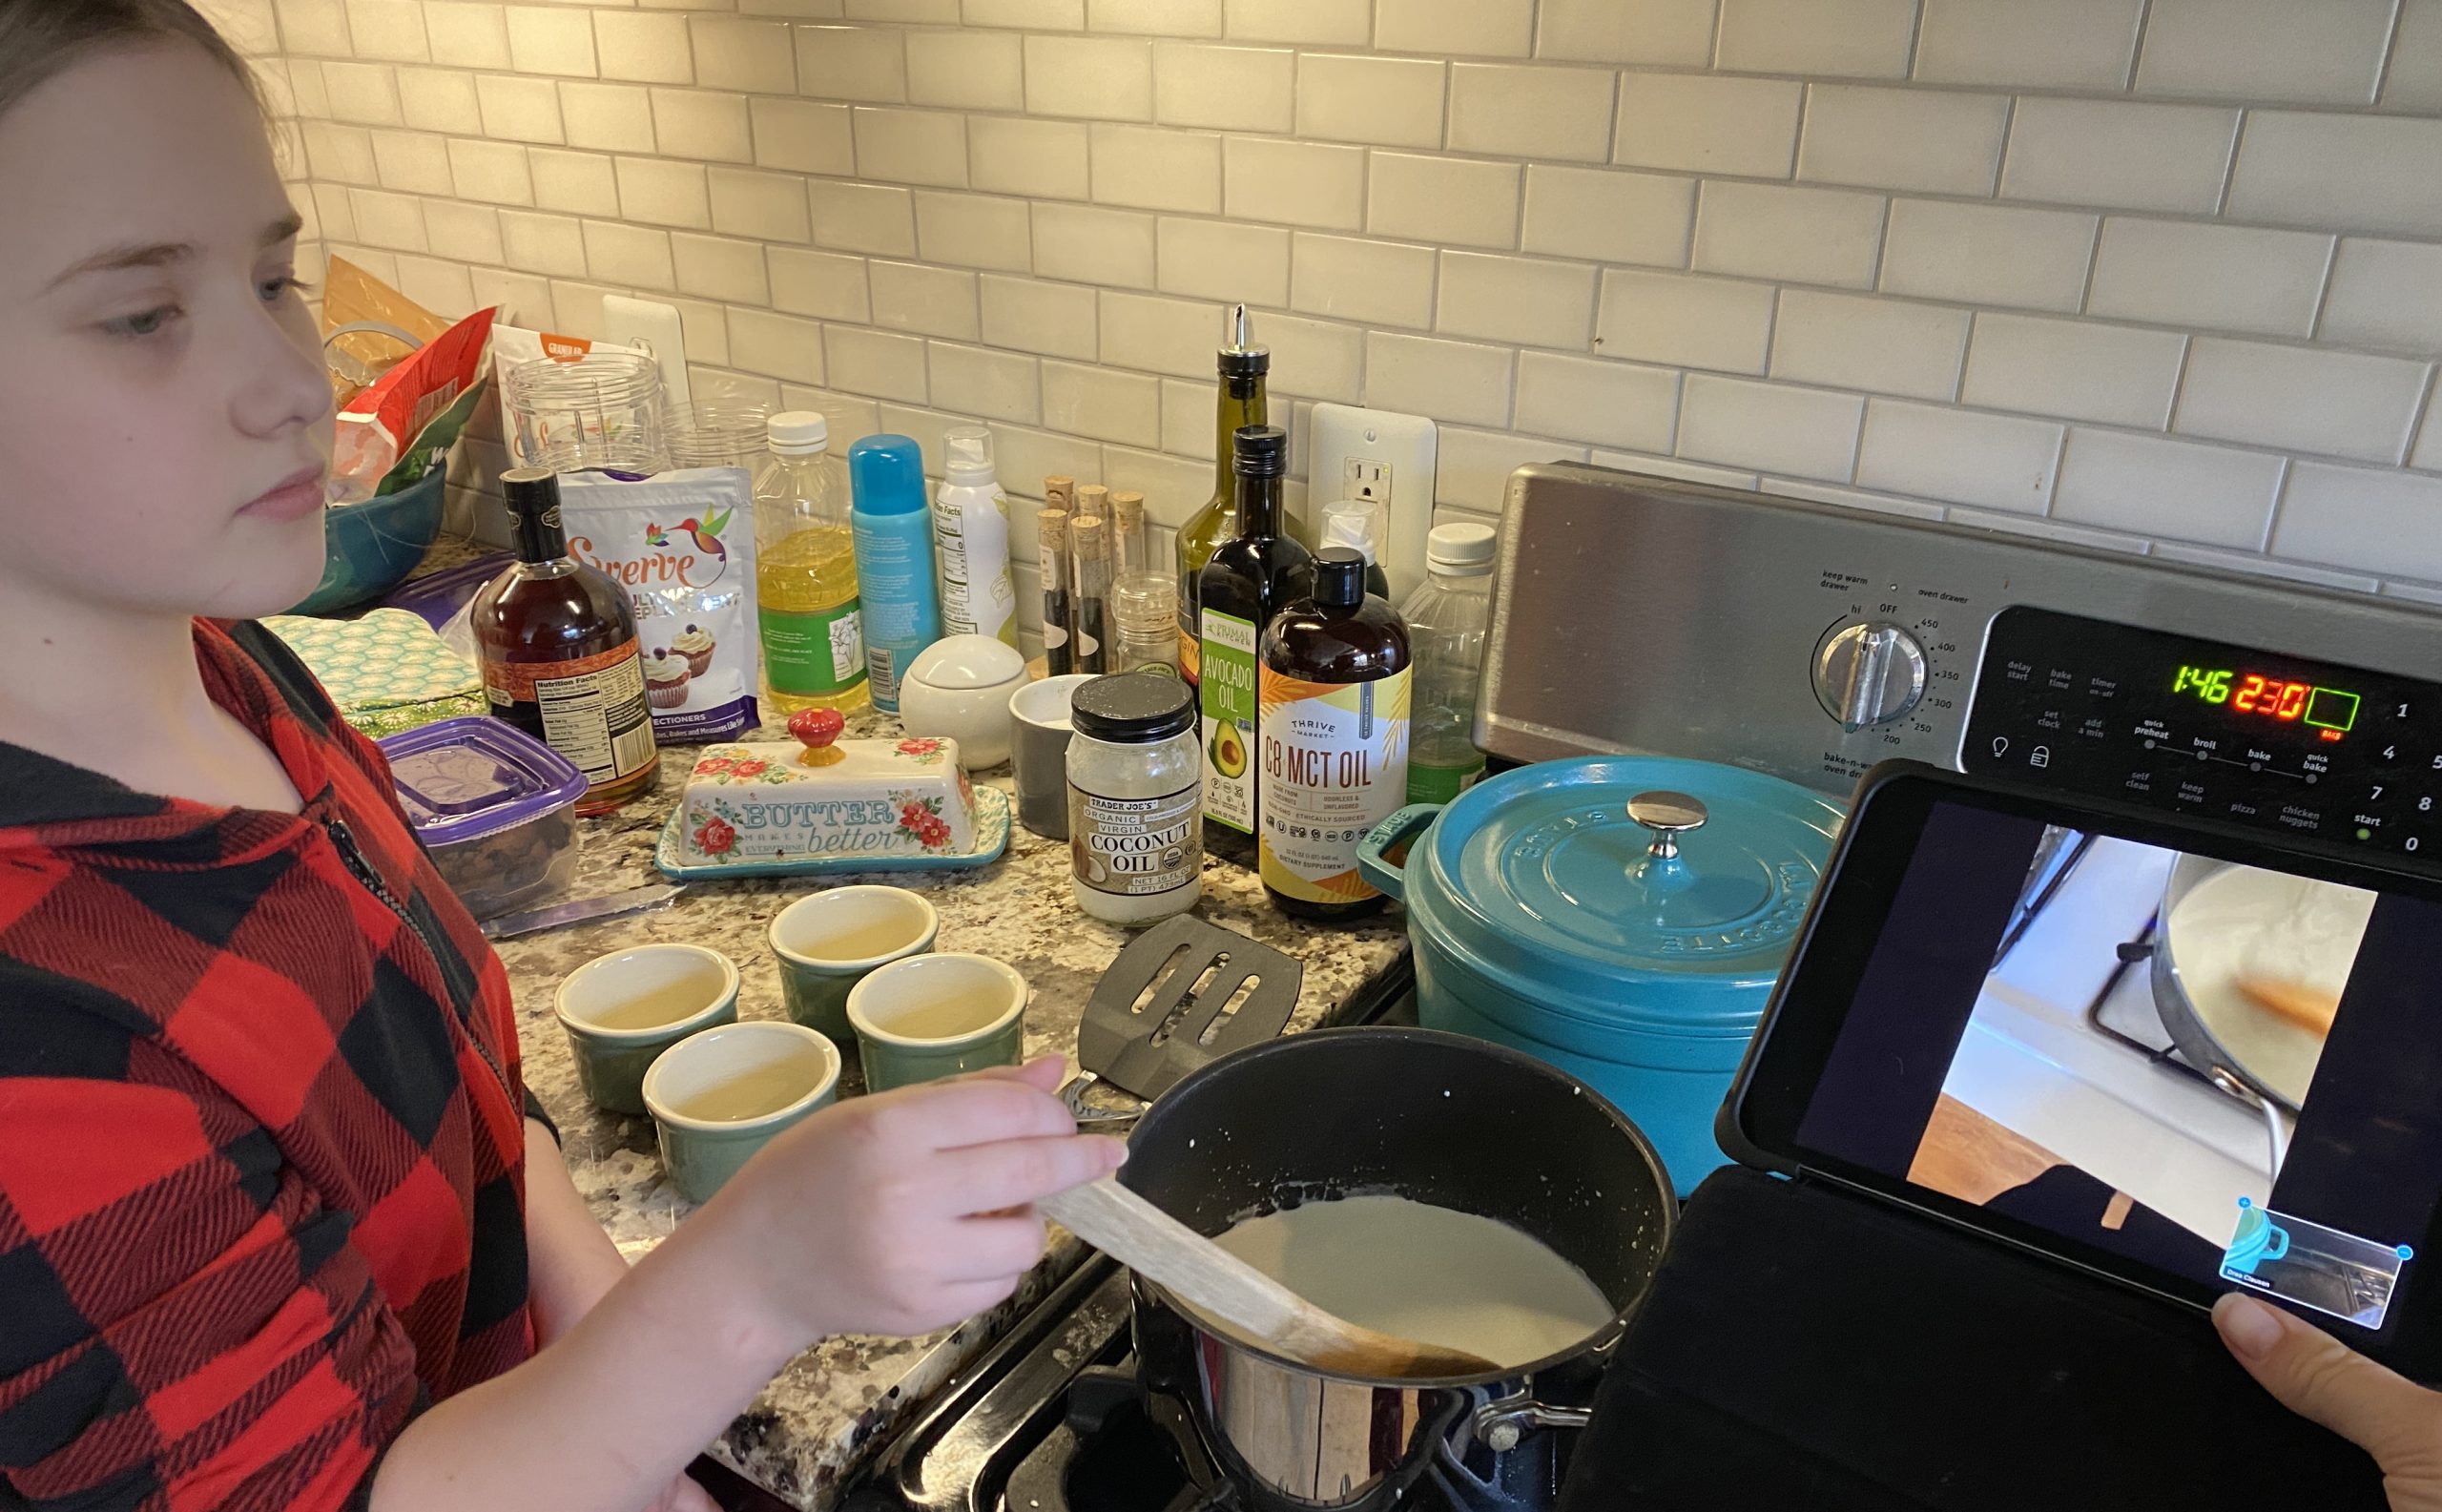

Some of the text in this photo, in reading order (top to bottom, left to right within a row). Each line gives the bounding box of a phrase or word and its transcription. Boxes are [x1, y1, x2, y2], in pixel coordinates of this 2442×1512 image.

[1823, 570, 1868, 586] keep warm
[1820, 579, 1850, 591] drawer
[1918, 588, 1969, 604] oven drawer
[1851, 605, 1862, 613] hi
[1879, 603, 1897, 613] OFF
[1921, 618, 1938, 629] 450
[1217, 623, 1250, 641] PRIMAL
[1937, 642, 1956, 652] 400
[2007, 660, 2032, 673] delay
[1205, 654, 1252, 692] AVOCADO
[1940, 671, 1959, 680] 350
[2007, 671, 2028, 681] start
[2050, 669, 2072, 679] bake
[537, 675, 597, 688] Nutrition Facts
[2049, 678, 2069, 690] time
[2091, 677, 2117, 689] timer
[2174, 666, 2233, 703] 1:46
[1219, 685, 1238, 713] OIL
[1935, 699, 1952, 709] 300
[2044, 711, 2059, 719] set
[2396, 703, 2409, 717] 1
[653, 714, 706, 725] ECTIONERS
[2038, 717, 2060, 730] clock
[2084, 718, 2102, 728] add
[2143, 719, 2164, 729] quick
[700, 725, 727, 735] Measures
[1292, 719, 1335, 733] THRIVE
[1914, 723, 1932, 733] 250
[1297, 730, 1328, 739] MARKET
[2085, 728, 2104, 738] min
[2134, 726, 2169, 740] preheat
[1883, 735, 1900, 744] 200
[2194, 736, 2217, 750] broil
[2247, 749, 2271, 761] bake
[2307, 753, 2328, 763] quick
[2383, 745, 2395, 759] 4
[1266, 735, 1372, 788] C8 MCT OIL
[2303, 760, 2327, 773] bake
[2432, 755, 2442, 769] 5
[1824, 764, 1846, 776] oven
[2131, 771, 2150, 780] self
[2125, 779, 2150, 791] clean
[2182, 781, 2204, 794] keep
[1284, 787, 1298, 798] FROM
[2178, 791, 2203, 803] warm
[2370, 786, 2383, 799] 7
[1091, 798, 1125, 810] TRADER
[2230, 803, 2256, 815] pizza
[2418, 797, 2432, 811] 8
[741, 799, 895, 830] BUTTER
[1085, 808, 1137, 824] ORGANIC
[1295, 814, 1332, 823] ETHICALLY
[1334, 814, 1366, 823] SOURCED
[2282, 805, 2320, 820] chicken
[2279, 813, 2318, 830] nuggets
[2354, 814, 2382, 827] start
[1100, 824, 1142, 834] VIRGIN
[745, 832, 803, 841] MAKES
[807, 826, 899, 853] better
[1091, 821, 1190, 853] COCONUT
[2405, 837, 2419, 851] 0
[1113, 855, 1155, 872] OIL
[1279, 855, 1345, 870] DIETARY SUPPLEMENT
[1169, 871, 1179, 880] FL
[1181, 866, 1190, 875] OZ
